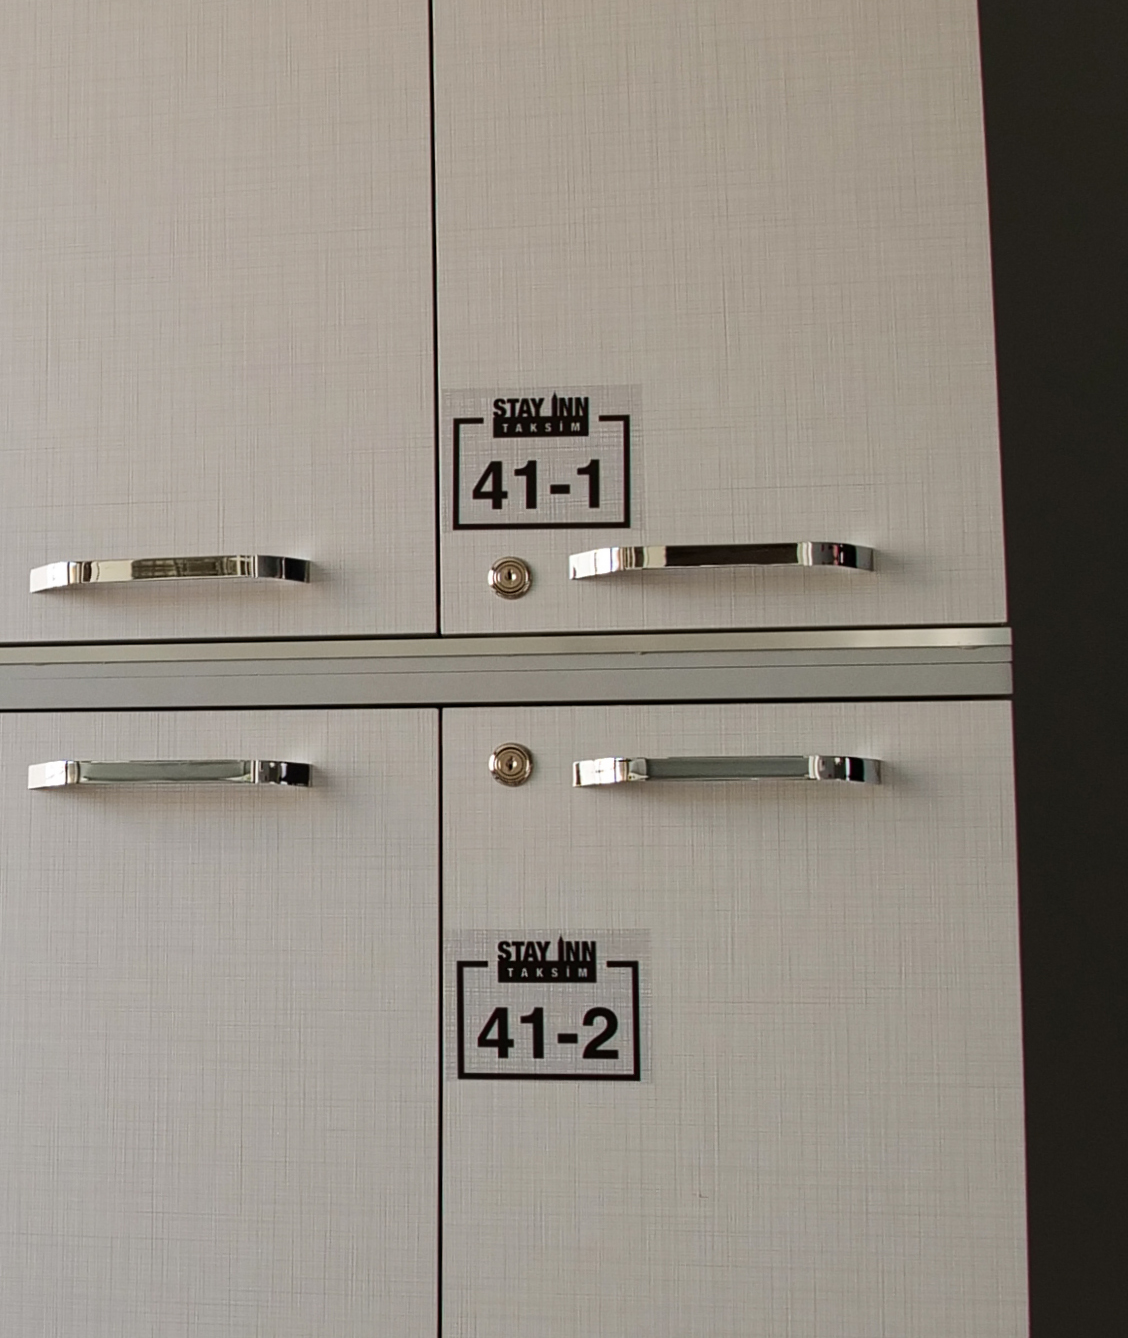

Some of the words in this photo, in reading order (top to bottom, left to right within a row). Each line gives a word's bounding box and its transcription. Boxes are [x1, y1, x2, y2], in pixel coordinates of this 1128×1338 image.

[493, 397, 545, 417] STAY
[472, 459, 600, 510] 41-1
[497, 941, 551, 961] STAY
[477, 1007, 619, 1059] 41-2
